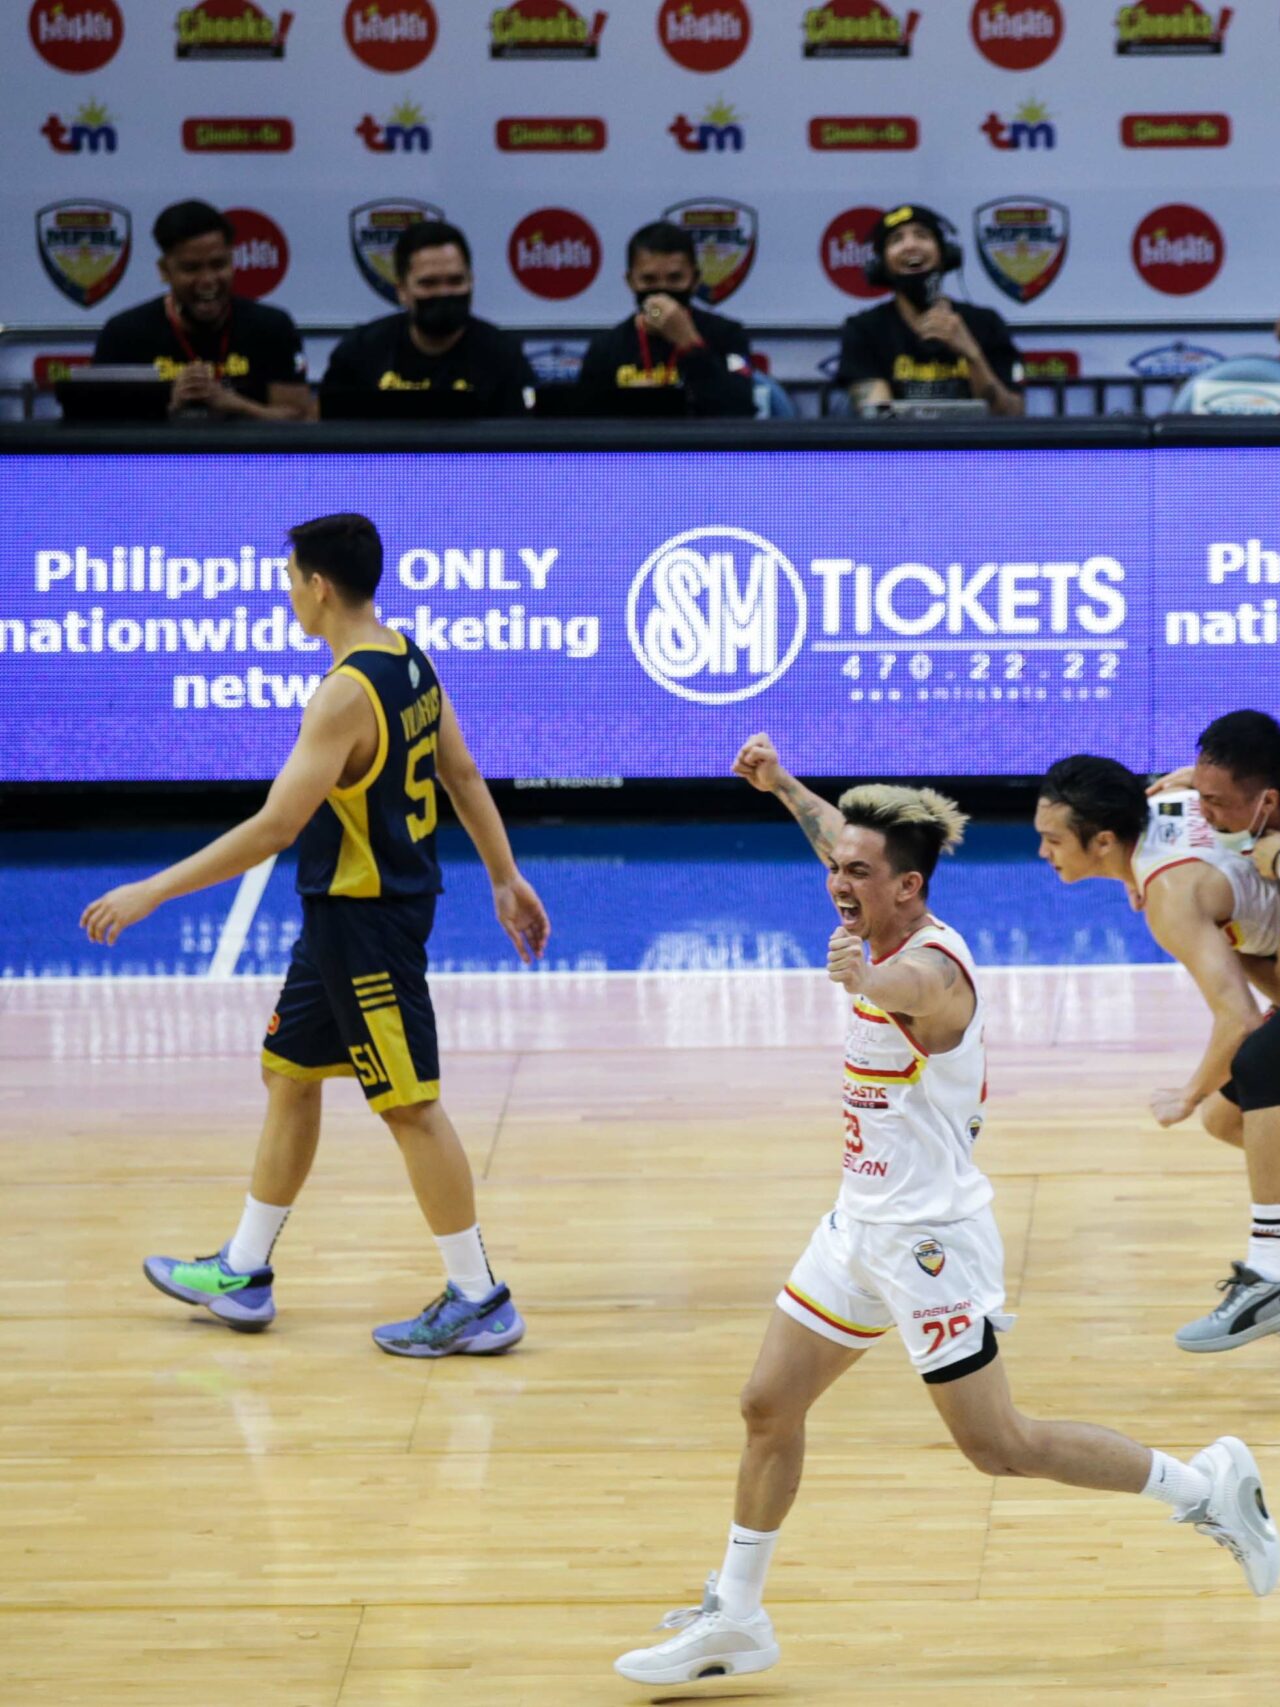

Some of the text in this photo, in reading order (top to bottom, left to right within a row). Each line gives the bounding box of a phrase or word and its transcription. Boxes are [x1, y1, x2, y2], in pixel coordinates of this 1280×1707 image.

[42, 114, 118, 154] tm
[356, 114, 432, 153] tm
[669, 113, 744, 151] tm
[982, 112, 1056, 149] tm
[398, 548, 557, 590] ONLY
[645, 548, 778, 677] SM
[811, 557, 1126, 635] TICKETS
[173, 667, 320, 708] netw
[348, 1042, 388, 1087] 51
[912, 1300, 972, 1319] BASILAN
